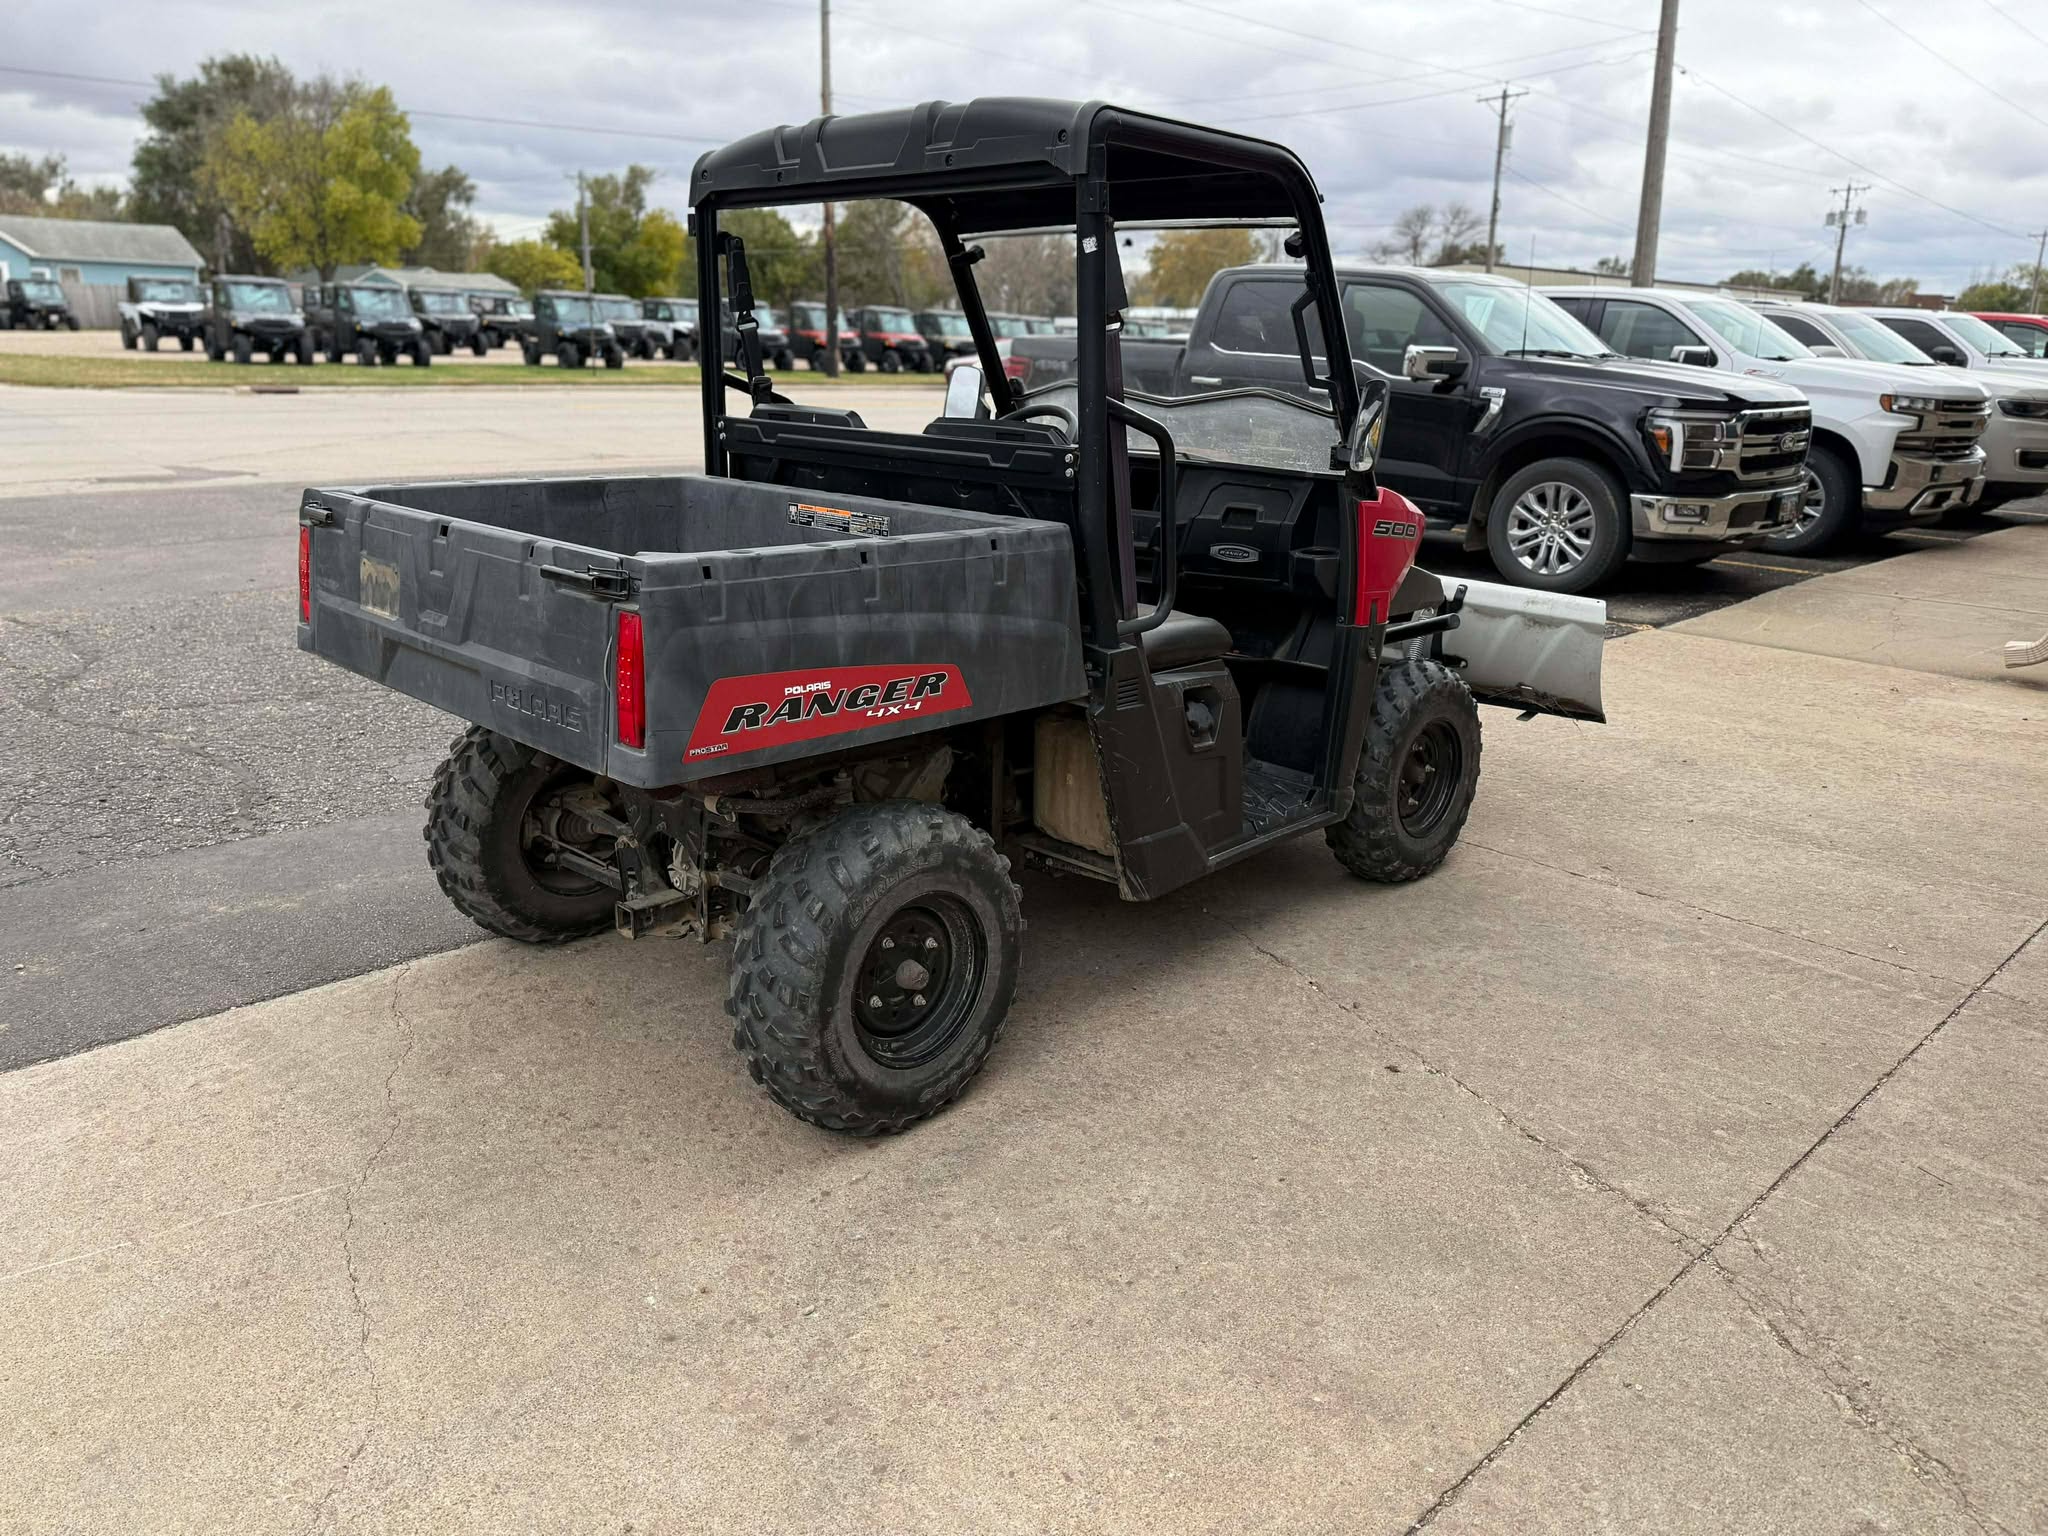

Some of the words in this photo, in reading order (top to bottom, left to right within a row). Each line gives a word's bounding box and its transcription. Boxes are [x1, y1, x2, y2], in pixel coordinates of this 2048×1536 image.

[1372, 519, 1416, 538] 500
[784, 681, 832, 696] POLARIS
[490, 680, 582, 733] POLARIS
[721, 672, 948, 734] RANGER
[689, 743, 729, 757] PROSTAR
